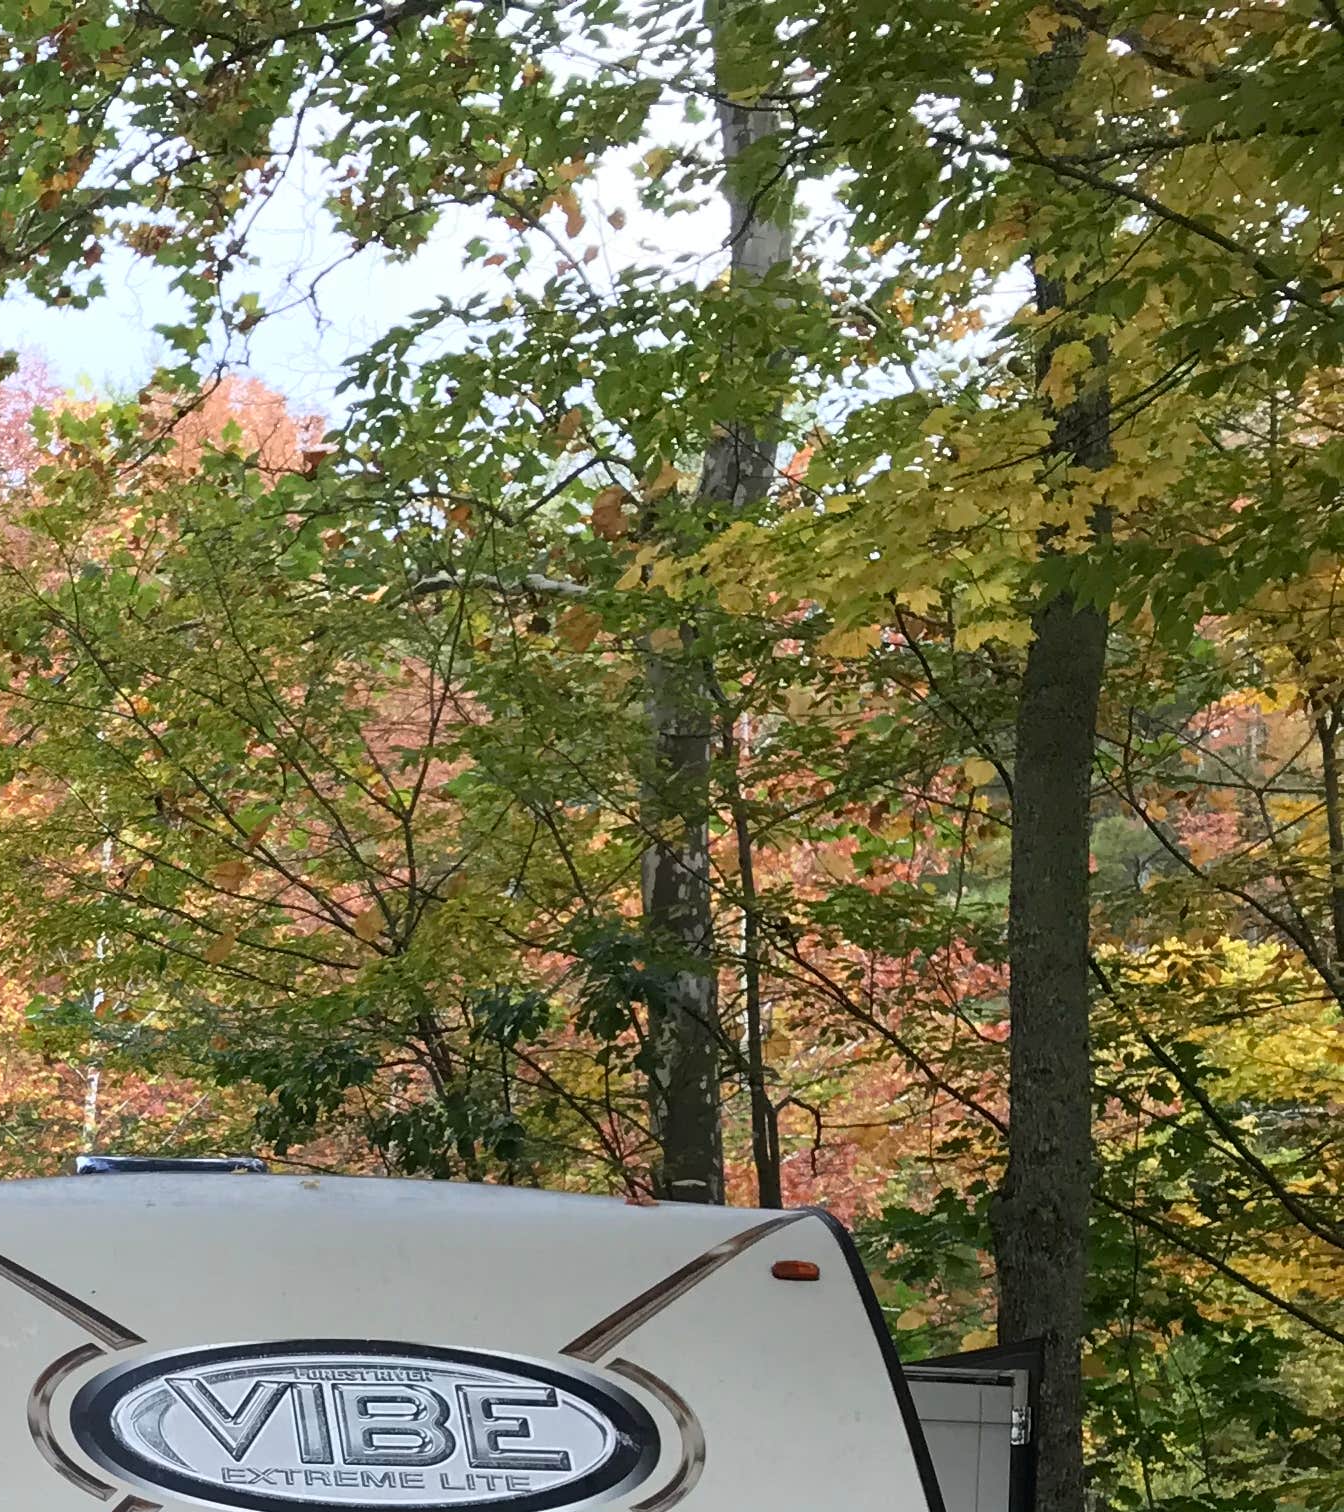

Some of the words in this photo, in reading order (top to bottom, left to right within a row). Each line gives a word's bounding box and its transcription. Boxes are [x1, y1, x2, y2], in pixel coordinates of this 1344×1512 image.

[294, 1367, 370, 1382] FOREST
[374, 1368, 433, 1382] RIVER
[165, 1376, 572, 1472] VIBE
[221, 1466, 425, 1491] EXTREME
[439, 1472, 531, 1493] LITE
